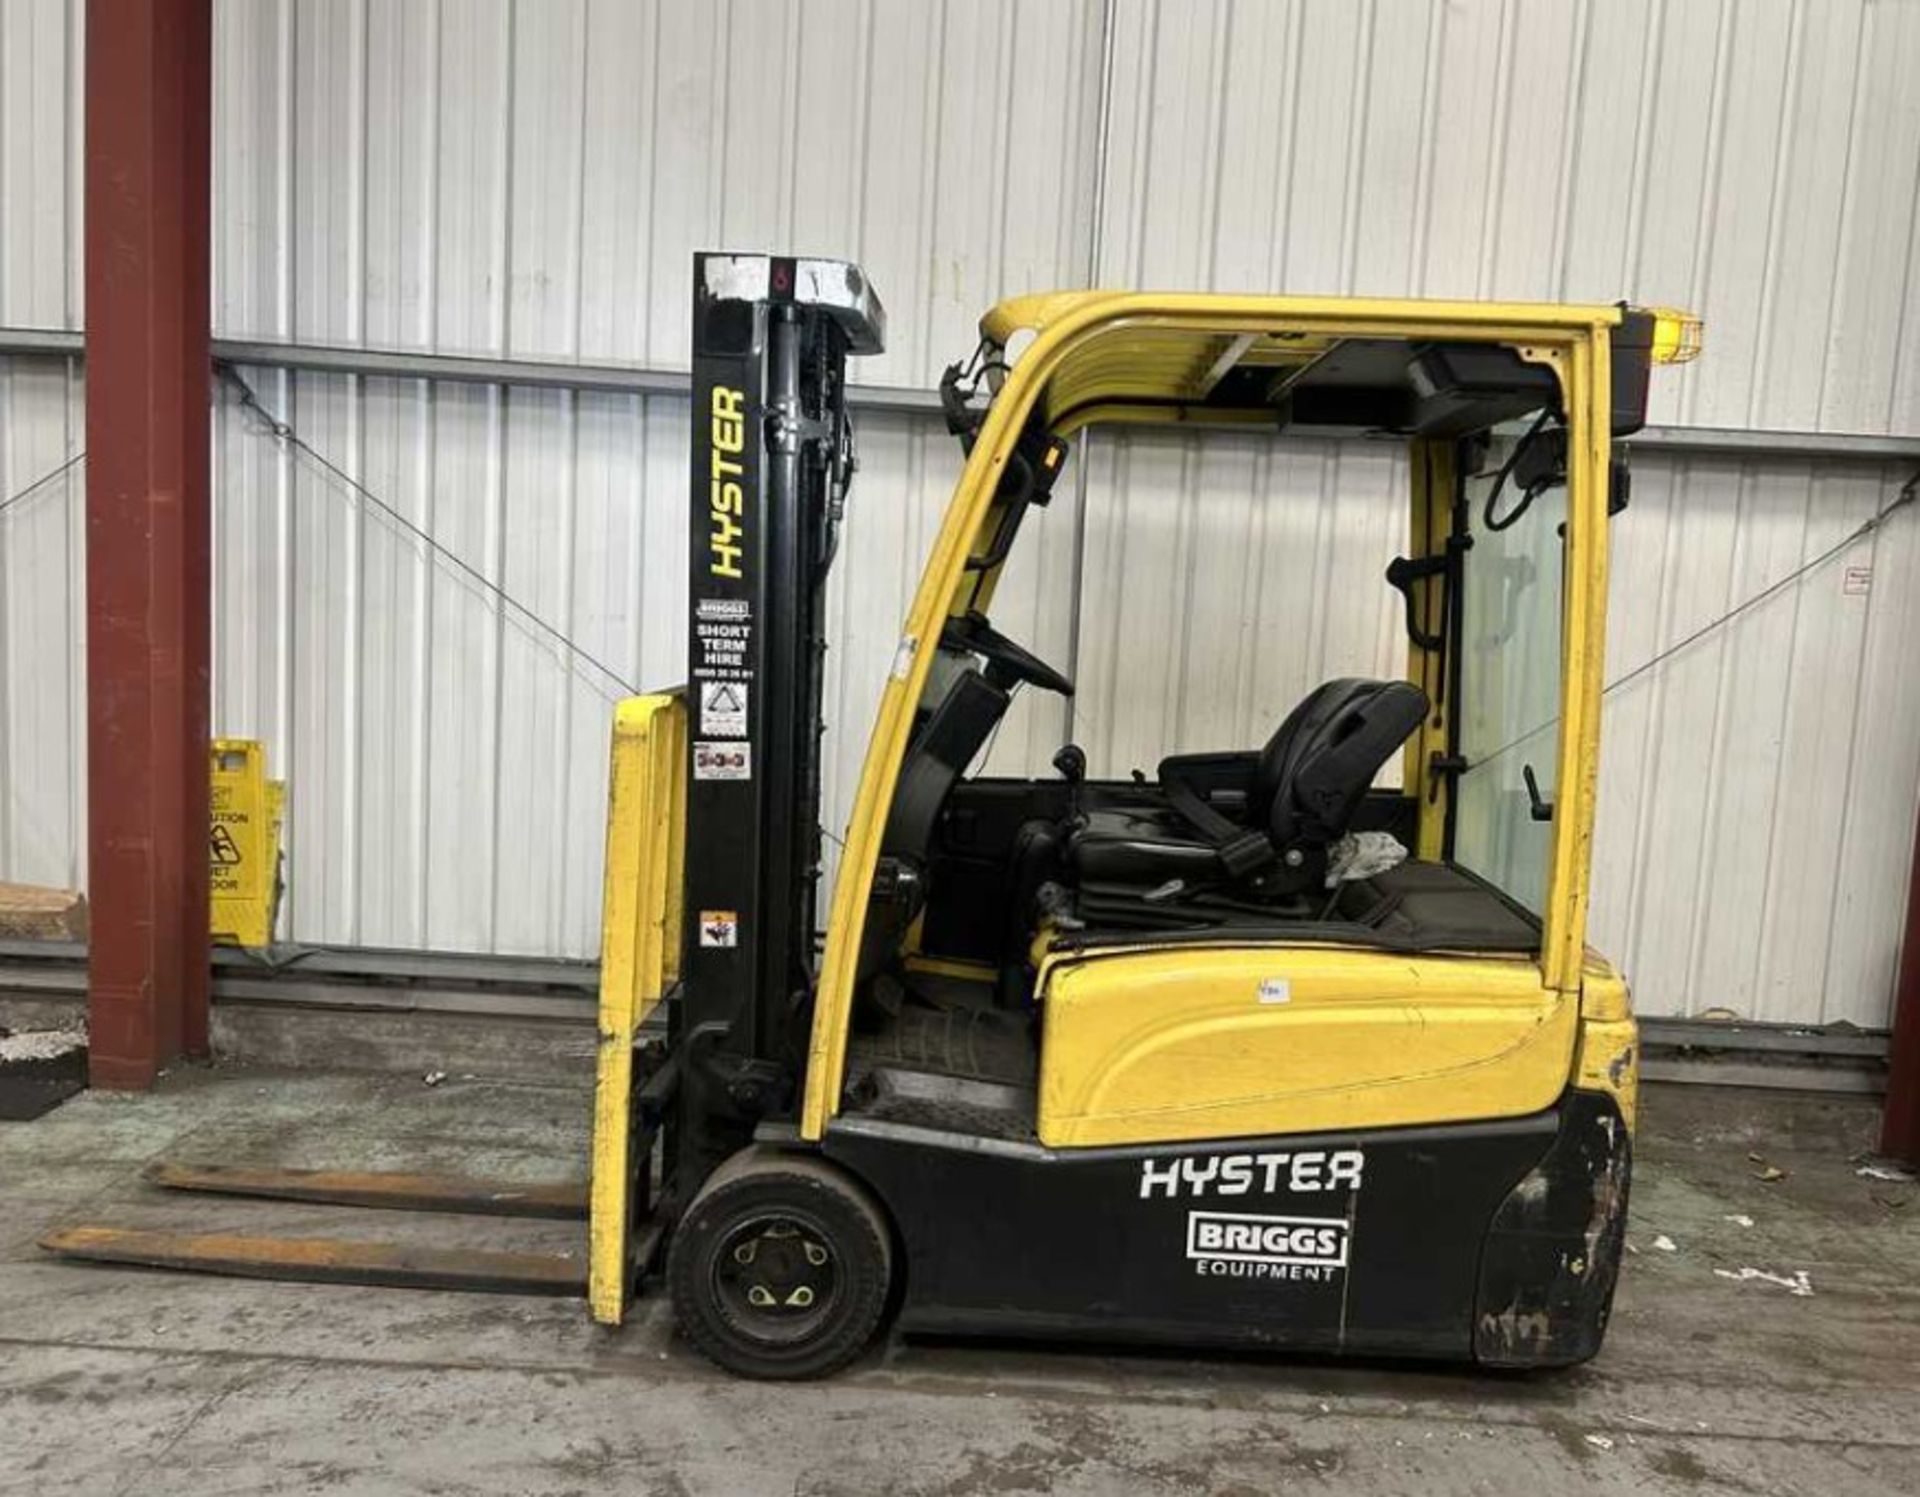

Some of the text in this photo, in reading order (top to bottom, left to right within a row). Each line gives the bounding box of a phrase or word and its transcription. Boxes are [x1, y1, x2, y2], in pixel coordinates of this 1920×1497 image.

[710, 386, 744, 579] HYSTER
[697, 624, 752, 638] SHORT
[702, 638, 747, 652] TERM
[704, 652, 742, 666] HIRE
[209, 867, 230, 877] ET
[1140, 1151, 1365, 1199] HYSTER
[1197, 1222, 1337, 1255] BRIGGS
[1195, 1259, 1336, 1282] EQUIPMENT
